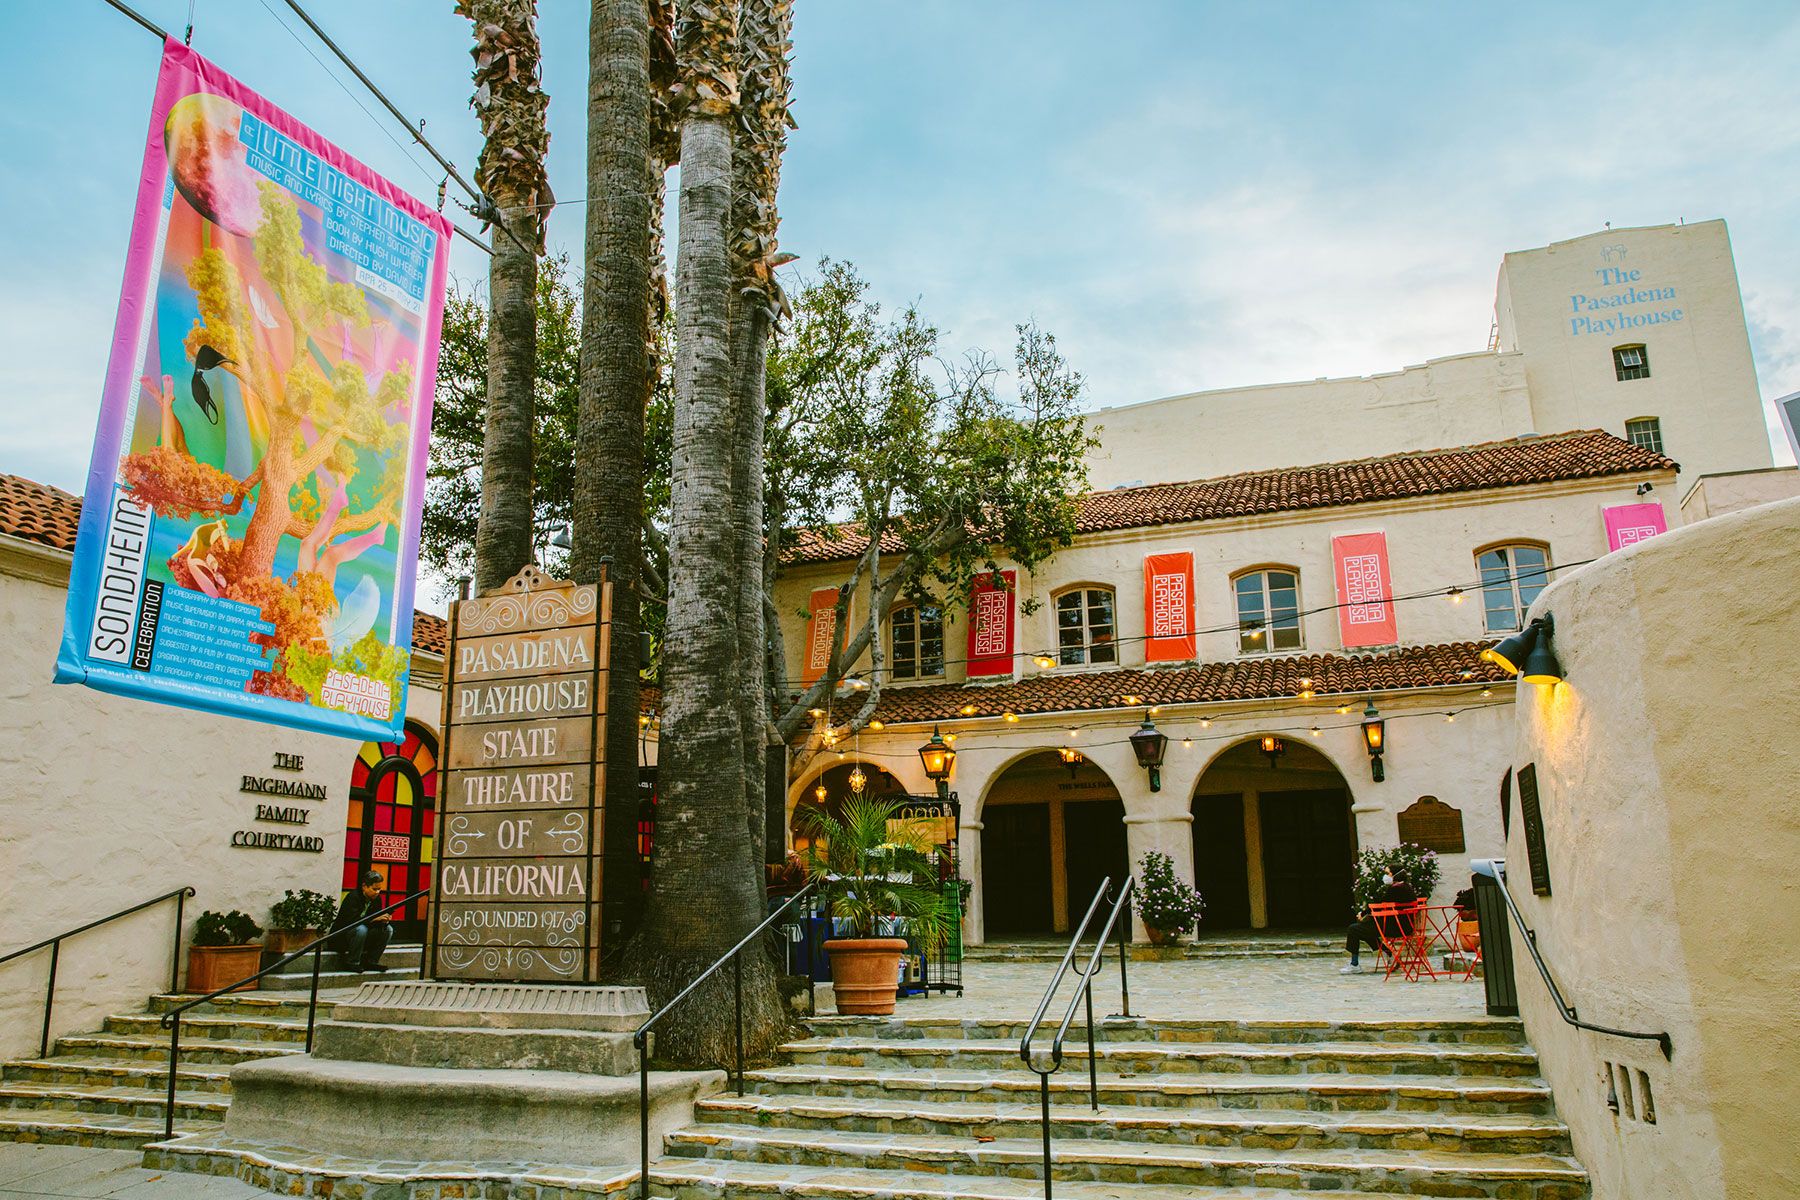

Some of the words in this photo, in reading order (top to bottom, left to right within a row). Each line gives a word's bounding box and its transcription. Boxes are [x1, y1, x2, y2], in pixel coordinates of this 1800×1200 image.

[250, 153, 282, 180] MUSIC
[284, 174, 302, 194] AND
[305, 186, 333, 213] LYRICS
[336, 206, 349, 220] BY
[350, 214, 386, 243] STEPHEN
[263, 130, 317, 181] LITTLE
[325, 170, 376, 217] NIGHT
[384, 207, 433, 253] MUSIC
[326, 217, 350, 239] BOOK
[352, 232, 364, 246] BY
[365, 239, 389, 261] HUGH
[329, 236, 369, 267] DIRECTED
[372, 260, 384, 273] BY
[359, 270, 377, 284] APR
[378, 279, 387, 292] 25
[1595, 267, 1641, 286] The
[1570, 287, 1676, 312] Pasadena
[1570, 309, 1684, 336] Playhouse
[94, 498, 147, 655] SONDHEIM
[1346, 558, 1366, 621] PLAYHOUSE
[1362, 556, 1383, 621] PASADENA
[165, 600, 184, 611] MUSIC
[210, 598, 218, 606] BY
[1155, 577, 1169, 637] PLAYHOUSE
[1170, 575, 1184, 636] PASADENA
[135, 585, 162, 668] CELEBRATION
[163, 612, 182, 623] MUSIC
[209, 623, 217, 631] BY
[992, 592, 1006, 652] PASADENA
[190, 645, 199, 653] BY
[206, 635, 215, 643] BY
[813, 611, 829, 667] PLAYHOUSE
[215, 663, 227, 673] AND
[459, 635, 591, 675] PASADENA
[194, 672, 203, 680] BY
[327, 670, 390, 699] PASADENA
[322, 690, 389, 718] PLAYHOUSE
[460, 679, 588, 717] PLAYHOUSE
[483, 727, 557, 760] STATE
[273, 752, 304, 771] THE
[240, 775, 328, 800] ENGEMANN
[463, 772, 574, 805] THEATRE
[255, 804, 310, 825] FAMILY
[231, 830, 324, 852] COURTYARD
[497, 819, 533, 849] OF
[442, 863, 586, 898] CALIFORNIA
[464, 909, 538, 928] FOUNDED
[541, 910, 565, 931] 1917
